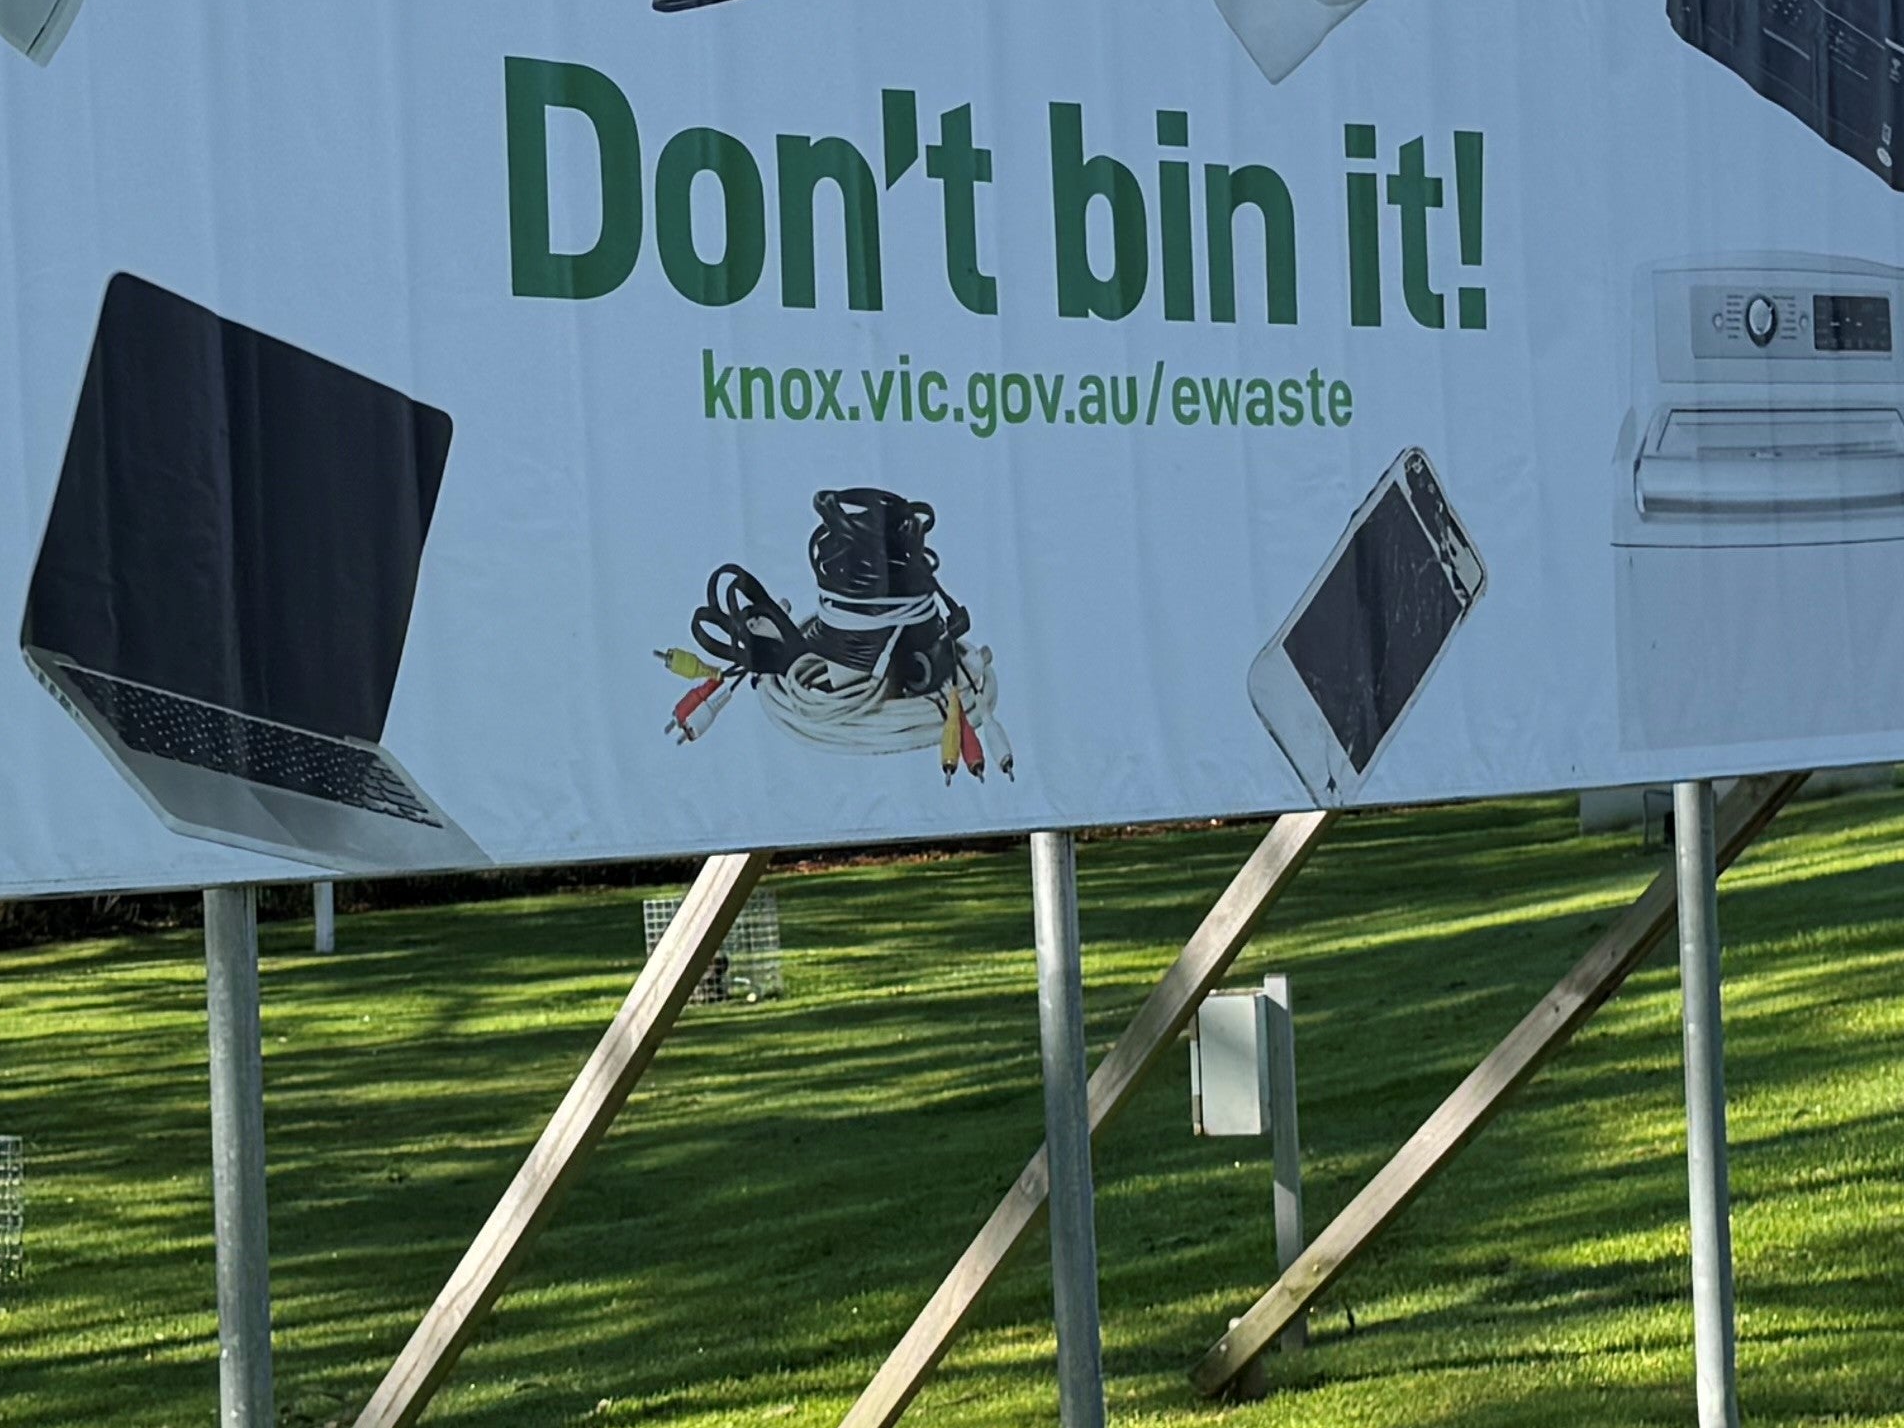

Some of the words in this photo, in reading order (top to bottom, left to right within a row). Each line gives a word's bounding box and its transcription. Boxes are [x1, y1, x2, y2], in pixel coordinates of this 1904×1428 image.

[502, 55, 999, 316] Don't
[1048, 102, 1299, 325] bin
[1343, 123, 1487, 329] it!
[701, 348, 1353, 439] knox.vic.gov.au/ewaste
